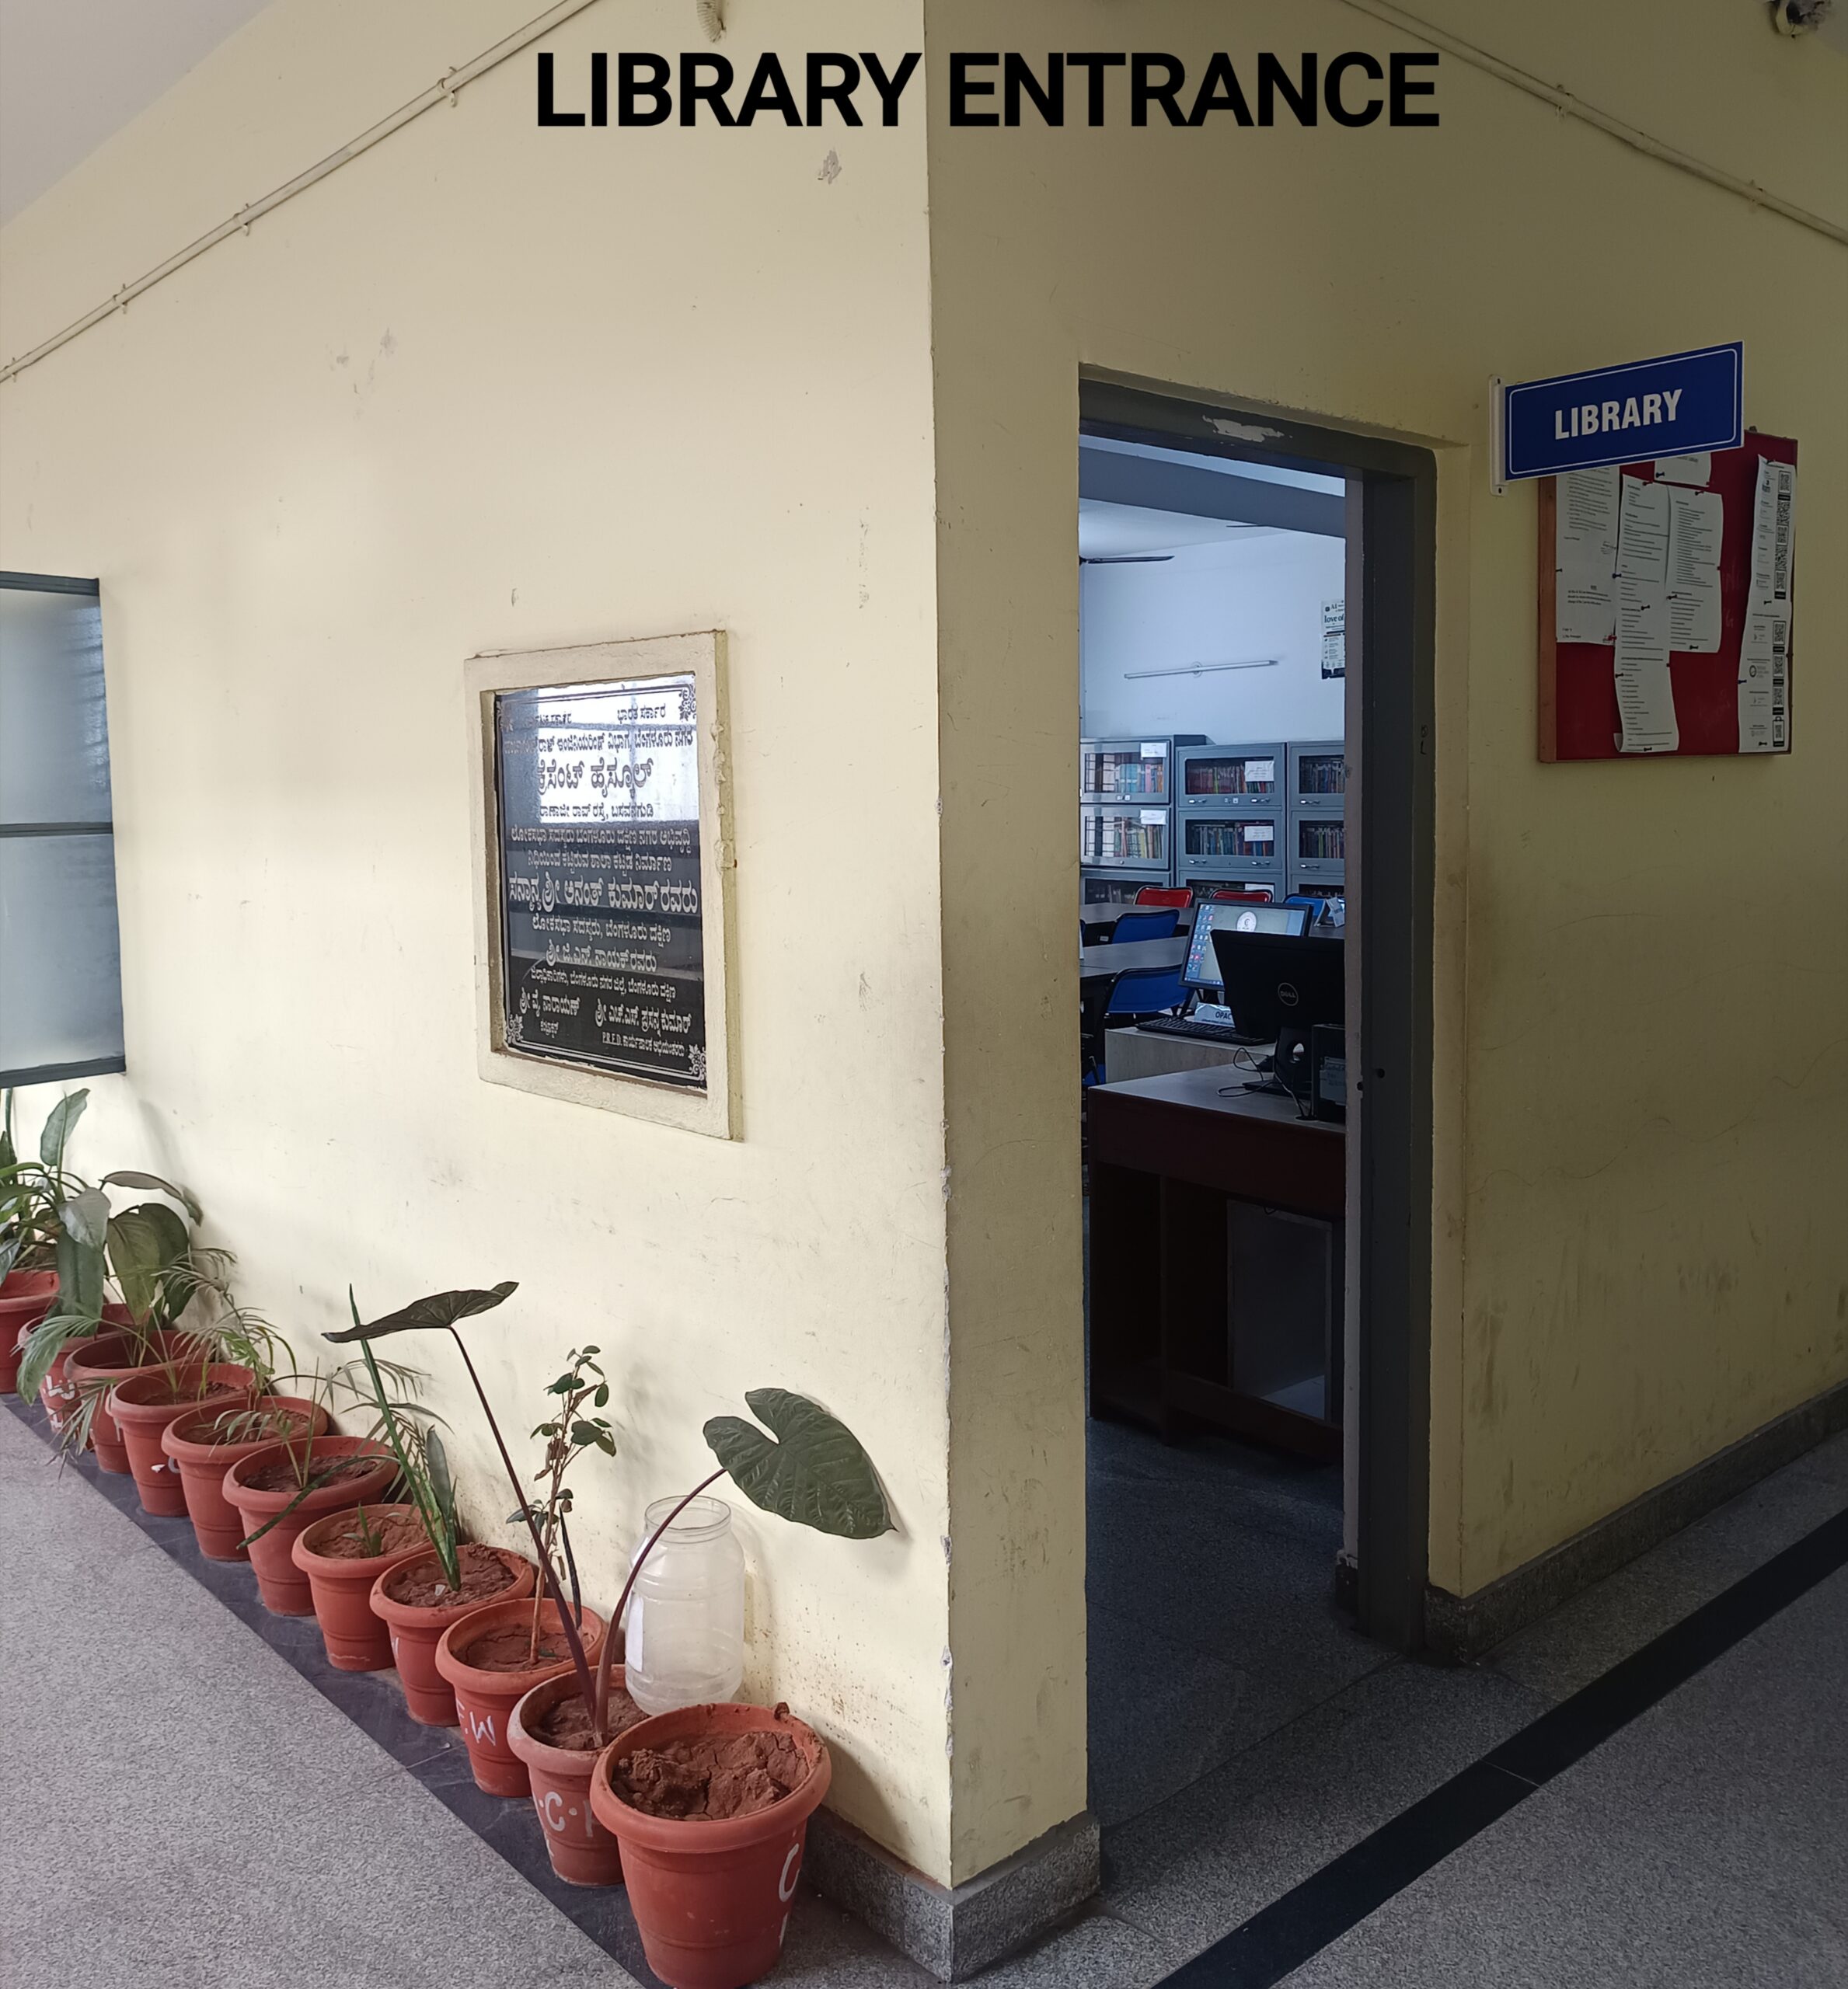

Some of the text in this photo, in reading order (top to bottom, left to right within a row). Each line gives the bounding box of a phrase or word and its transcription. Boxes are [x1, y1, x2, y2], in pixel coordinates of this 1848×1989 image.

[1555, 388, 1682, 440] LIBRARY
[617, 705, 638, 724] ಭಾರತ
[591, 757, 654, 799] ಹೈಸ್ಕೂಲ್
[611, 802, 654, 818] ಬಸವನಗುಡಿ
[511, 824, 547, 846] ಲೋಕಸಭಾ
[639, 829, 658, 846] ನಗರ
[591, 854, 612, 869] ಶಾಲಾ
[613, 851, 633, 876] ಕಟ್ಟಡ
[635, 852, 672, 871] ನಿರ್ಮಾಣ
[542, 871, 560, 912] ಶ್ರೀ
[564, 875, 604, 906] ಅನಂತ್
[532, 912, 571, 935] ಲೋಕಸಭಾ
[605, 919, 647, 940] ಬೆಂಗಳೂರು
[546, 939, 560, 967] ಶ್ರೀ
[628, 977, 659, 996] ಬೆಂಗಳೂರು
[519, 987, 530, 1014] ಶ್ರೀ
[595, 998, 607, 1027] ಶ್ರೀ
